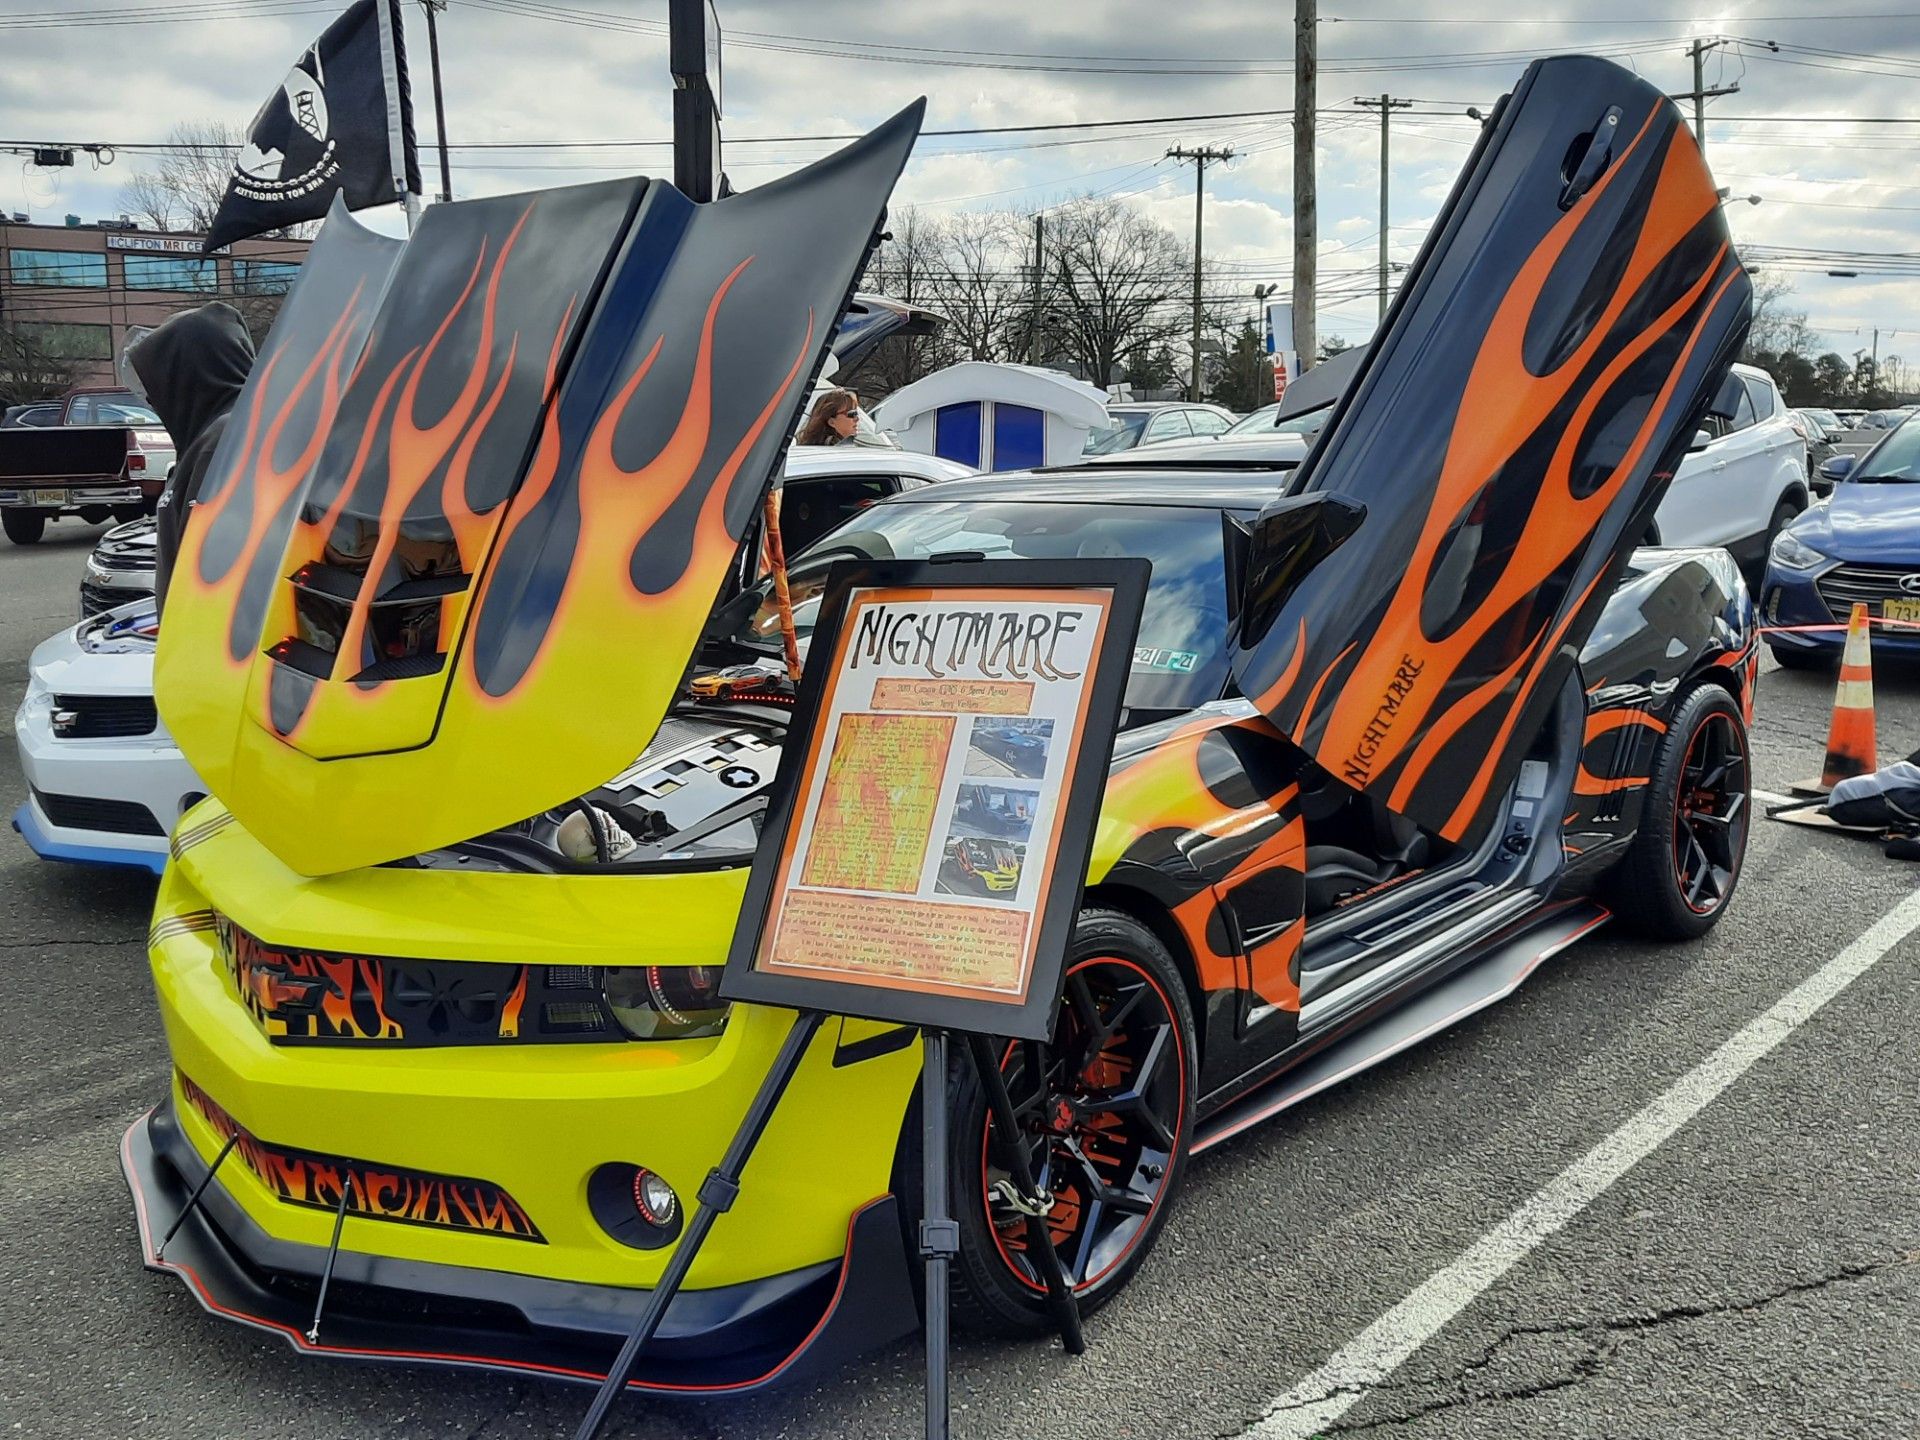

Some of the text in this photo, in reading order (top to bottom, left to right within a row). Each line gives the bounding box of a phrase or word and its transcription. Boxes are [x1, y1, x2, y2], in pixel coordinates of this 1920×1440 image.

[117, 237, 160, 249] CLIFTON
[164, 240, 184, 250] MRI
[850, 605, 1083, 682] NIGHTMARE
[1181, 654, 1193, 668] 21
[1342, 653, 1425, 789] NIGHTMARE
